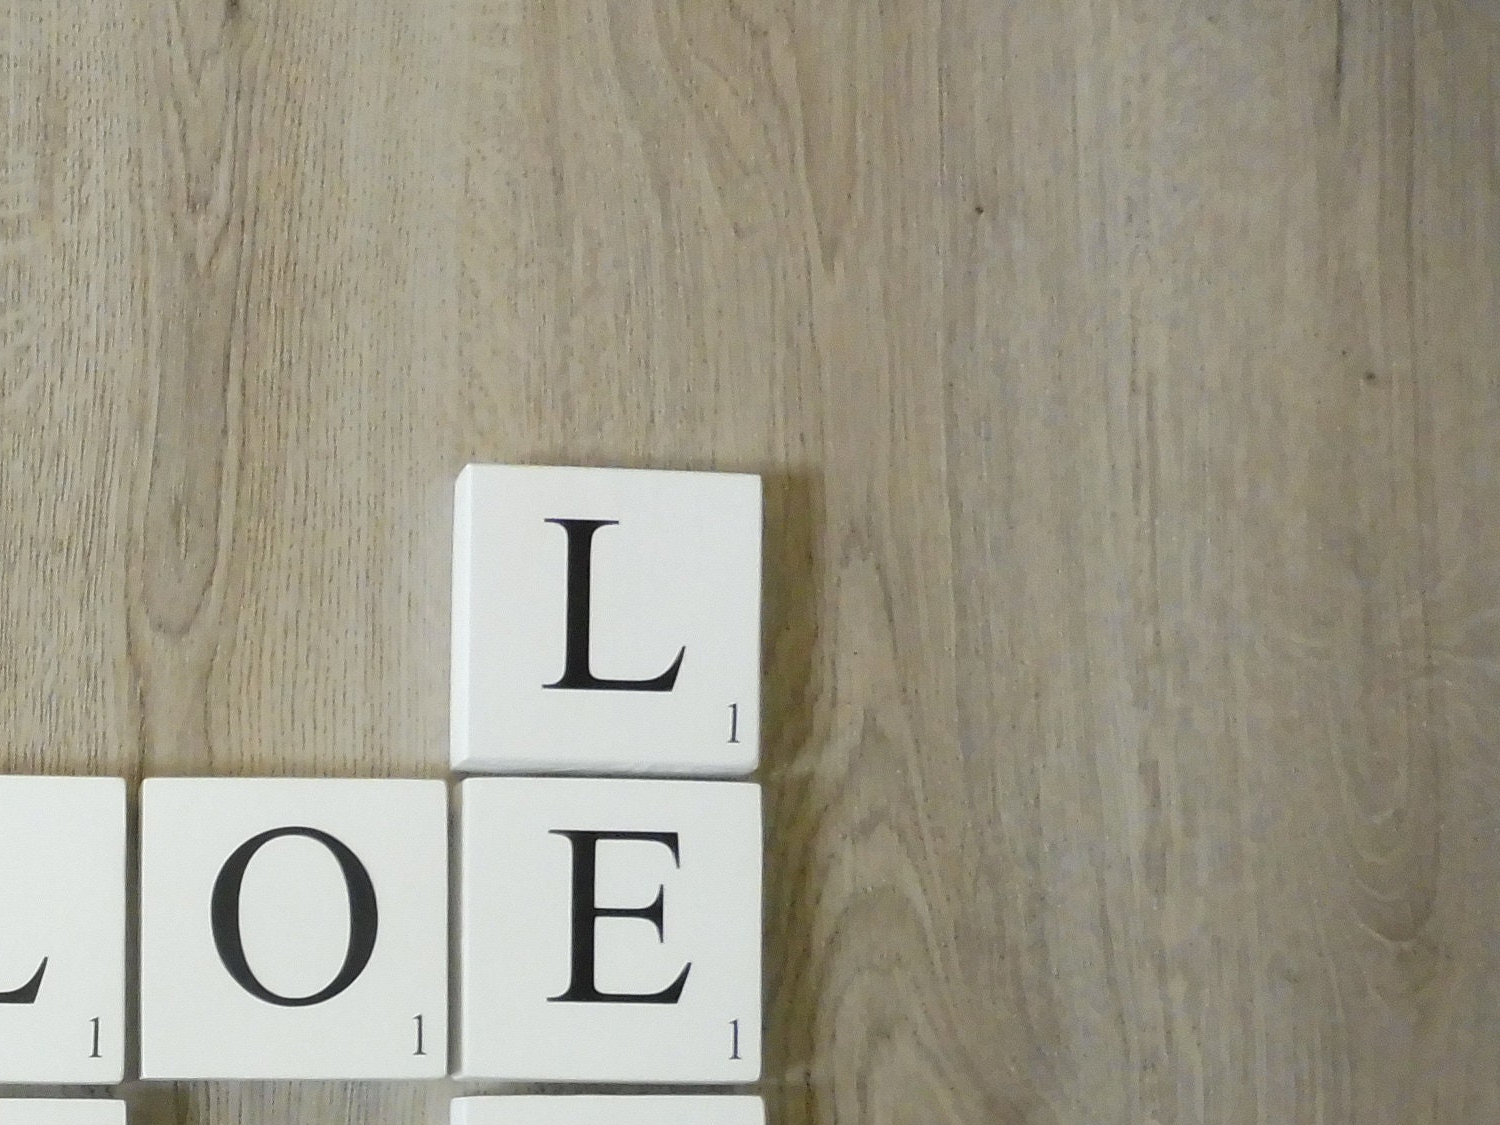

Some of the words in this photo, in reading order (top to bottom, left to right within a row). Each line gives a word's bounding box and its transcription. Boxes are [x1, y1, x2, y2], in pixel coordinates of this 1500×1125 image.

[540, 517, 687, 693] L
[727, 702, 741, 744] 1
[209, 825, 379, 1008] O
[545, 828, 693, 1005] E
[88, 1016, 103, 1059] 1
[412, 1013, 427, 1056] 1
[728, 1018, 743, 1061] 1
